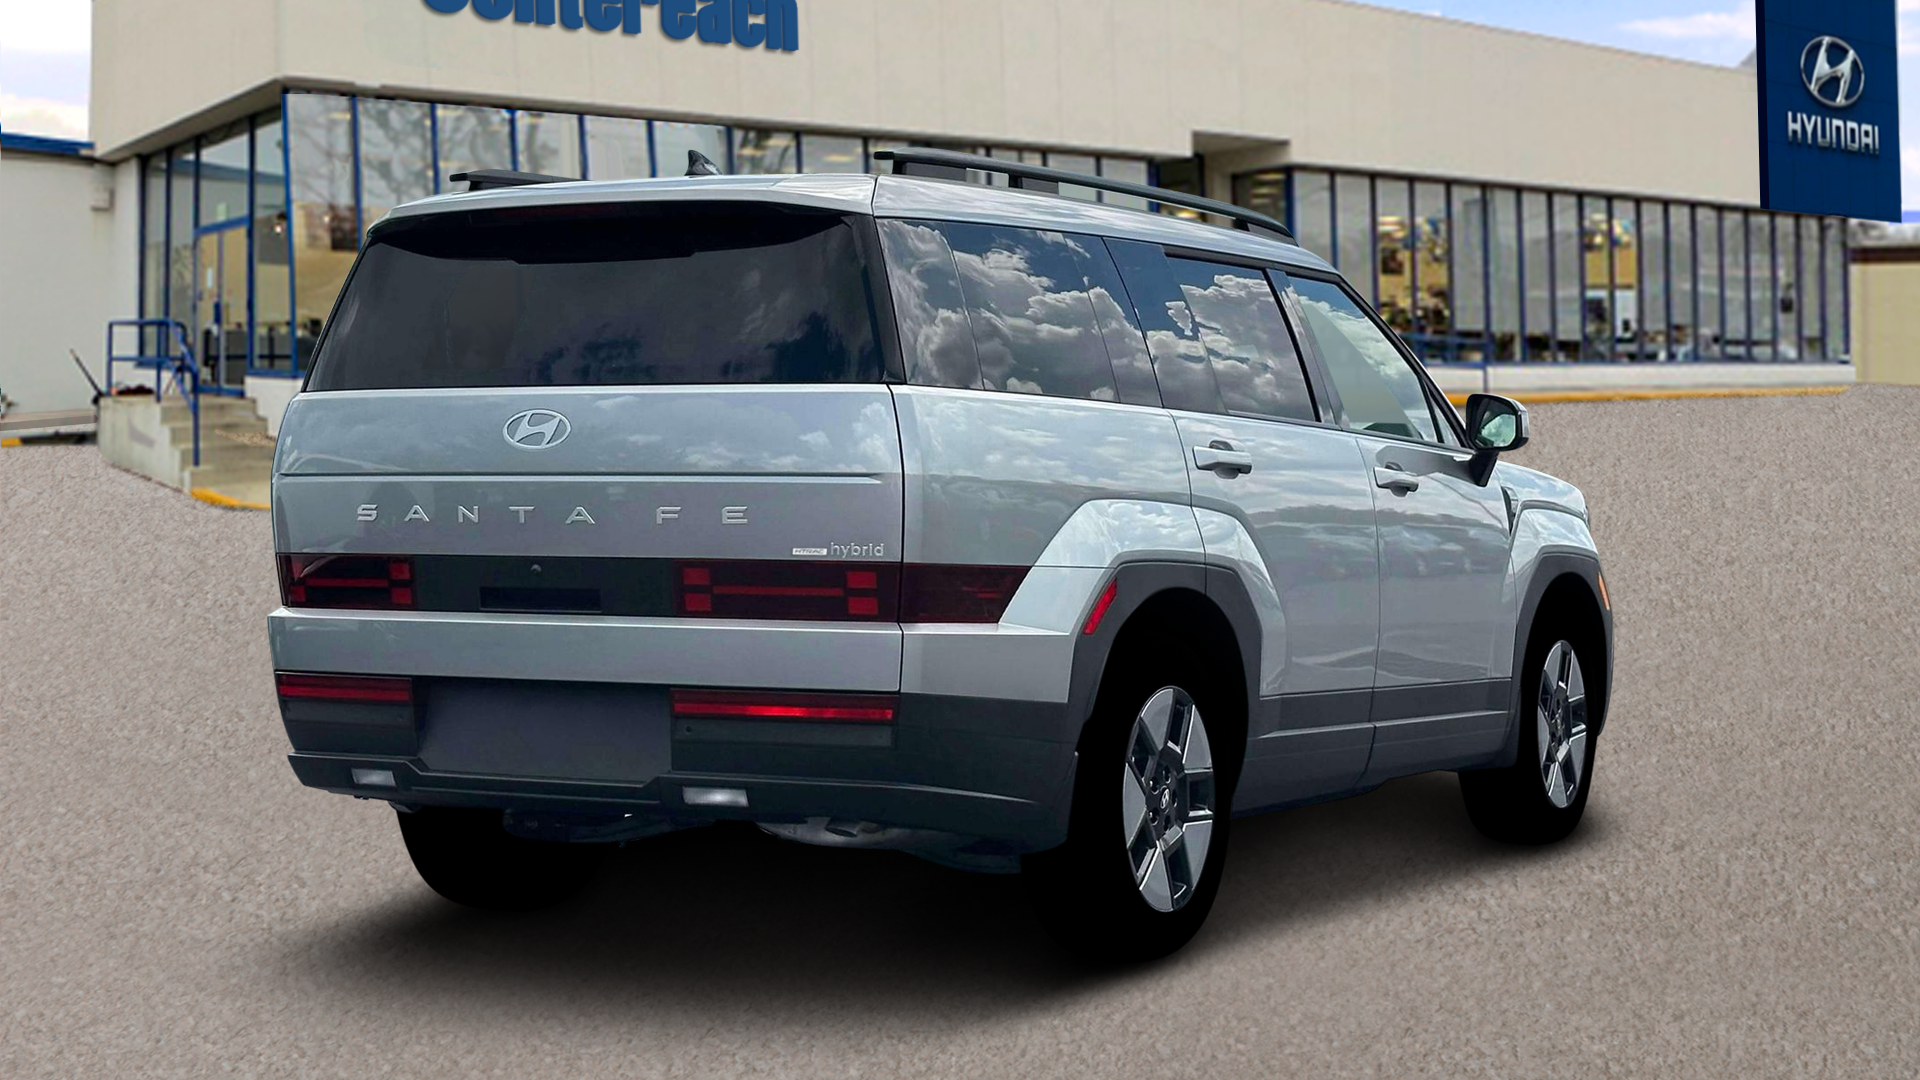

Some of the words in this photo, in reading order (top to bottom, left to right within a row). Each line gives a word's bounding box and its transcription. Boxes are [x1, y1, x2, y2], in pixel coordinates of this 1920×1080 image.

[422, 0, 799, 51] ereach
[1787, 111, 1880, 155] HYUNDAI
[357, 504, 596, 526] SANTA
[656, 506, 749, 526] FE
[830, 542, 885, 558] hybrid
